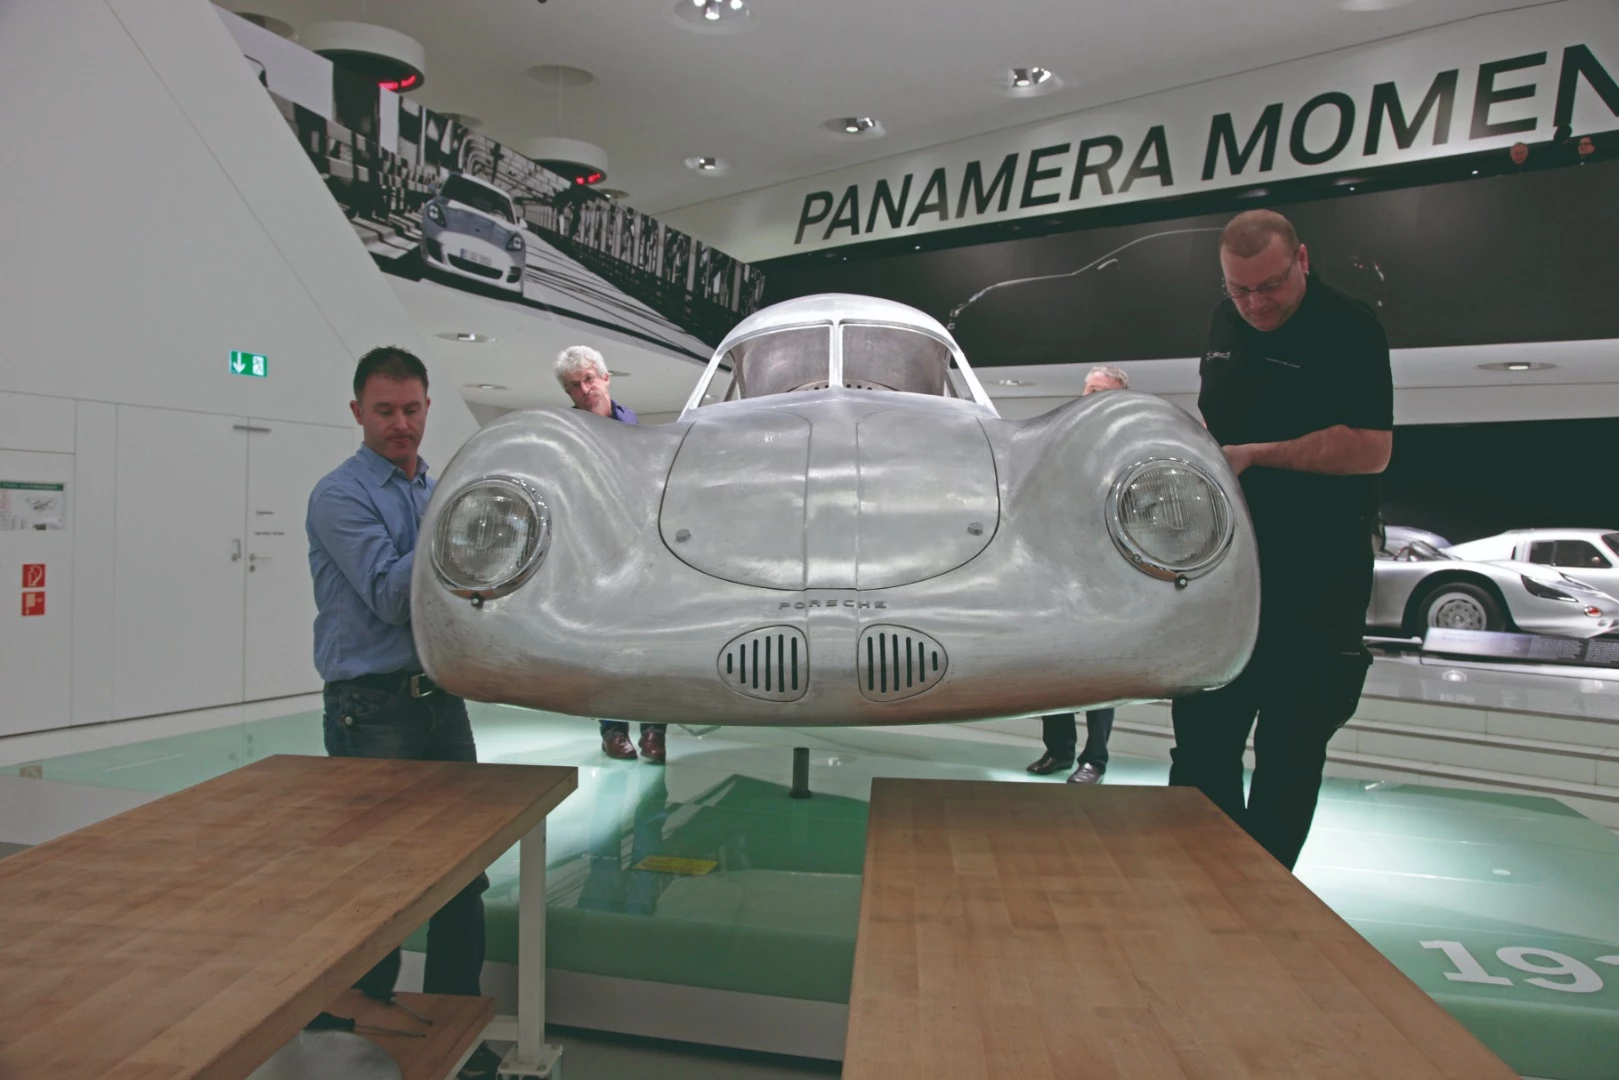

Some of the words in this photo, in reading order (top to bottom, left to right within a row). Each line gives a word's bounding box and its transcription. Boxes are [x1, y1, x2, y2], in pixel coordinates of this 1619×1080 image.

[794, 125, 1173, 244] PANAMERA
[778, 600, 886, 609] PORSCHE
[1418, 940, 1619, 993] 19
